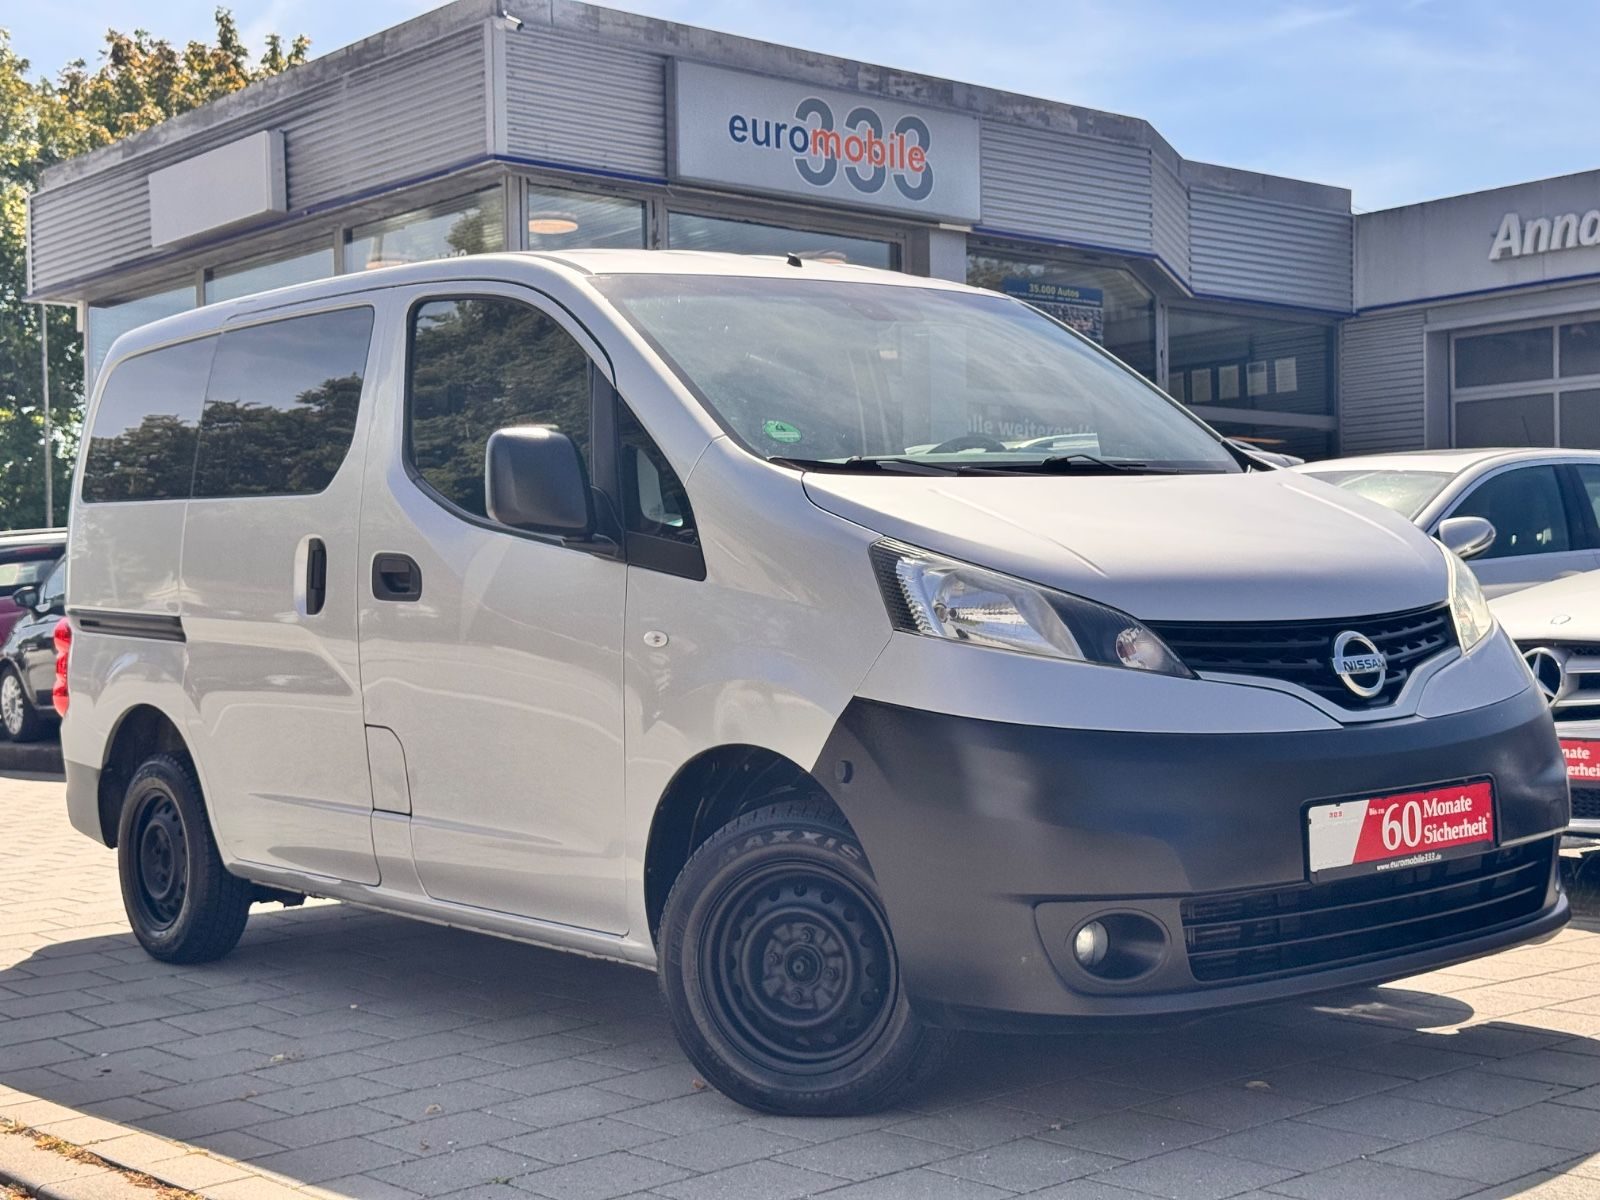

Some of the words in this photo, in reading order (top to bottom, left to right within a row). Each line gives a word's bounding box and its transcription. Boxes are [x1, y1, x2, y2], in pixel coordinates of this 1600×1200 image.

[728, 114, 926, 173] euromobile
[794, 97, 935, 201] 333
[1029, 283, 1056, 295] 35.000
[1057, 287, 1080, 298] Autos
[1422, 795, 1472, 818] Monate
[1382, 800, 1422, 851] 60
[1376, 852, 1442, 871] www.euromobile333.de
